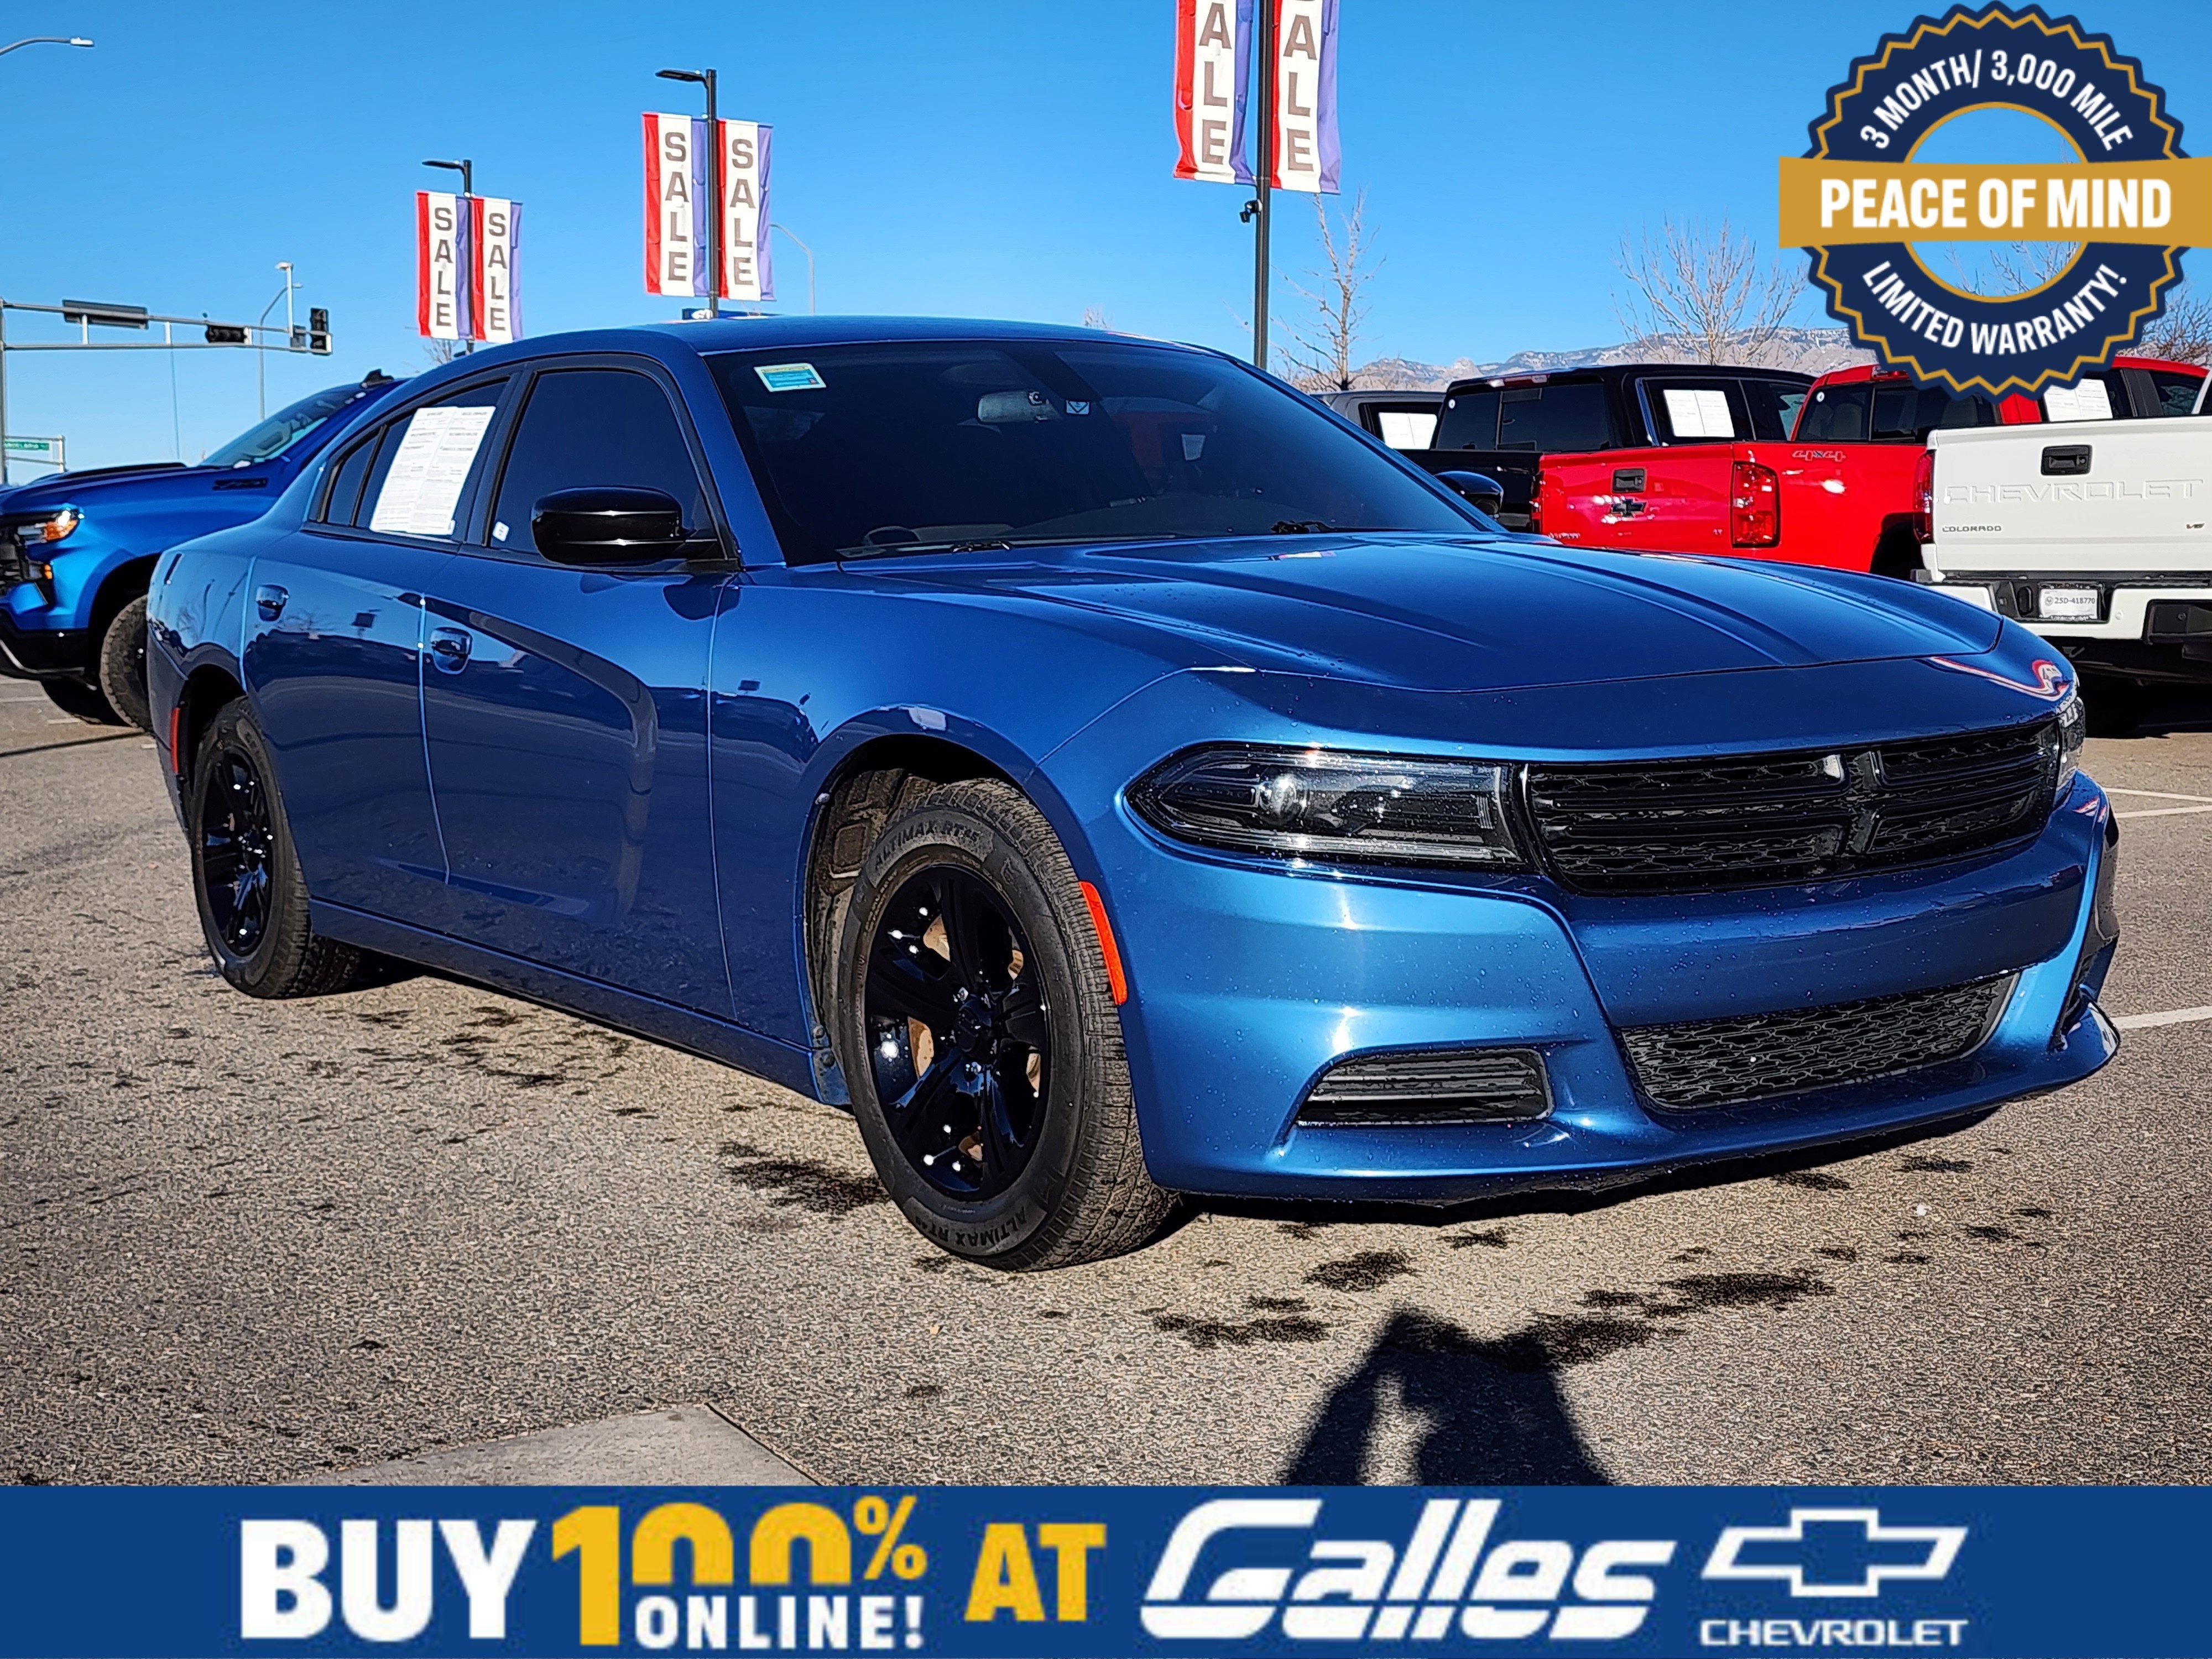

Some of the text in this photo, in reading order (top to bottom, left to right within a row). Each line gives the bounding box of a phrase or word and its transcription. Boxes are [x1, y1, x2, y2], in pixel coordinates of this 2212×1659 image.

[1199, 3, 1232, 165] ALE
[1283, 0, 1317, 171] ALE
[434, 207, 453, 327] SALE
[664, 132, 689, 282] SALE
[729, 138, 756, 286] SALE
[488, 212, 508, 331] SALE
[1944, 478, 2204, 503] CHEVROLET
[875, 820, 938, 870] ALTIMAX
[956, 1205, 1027, 1247] ALTIMAX
